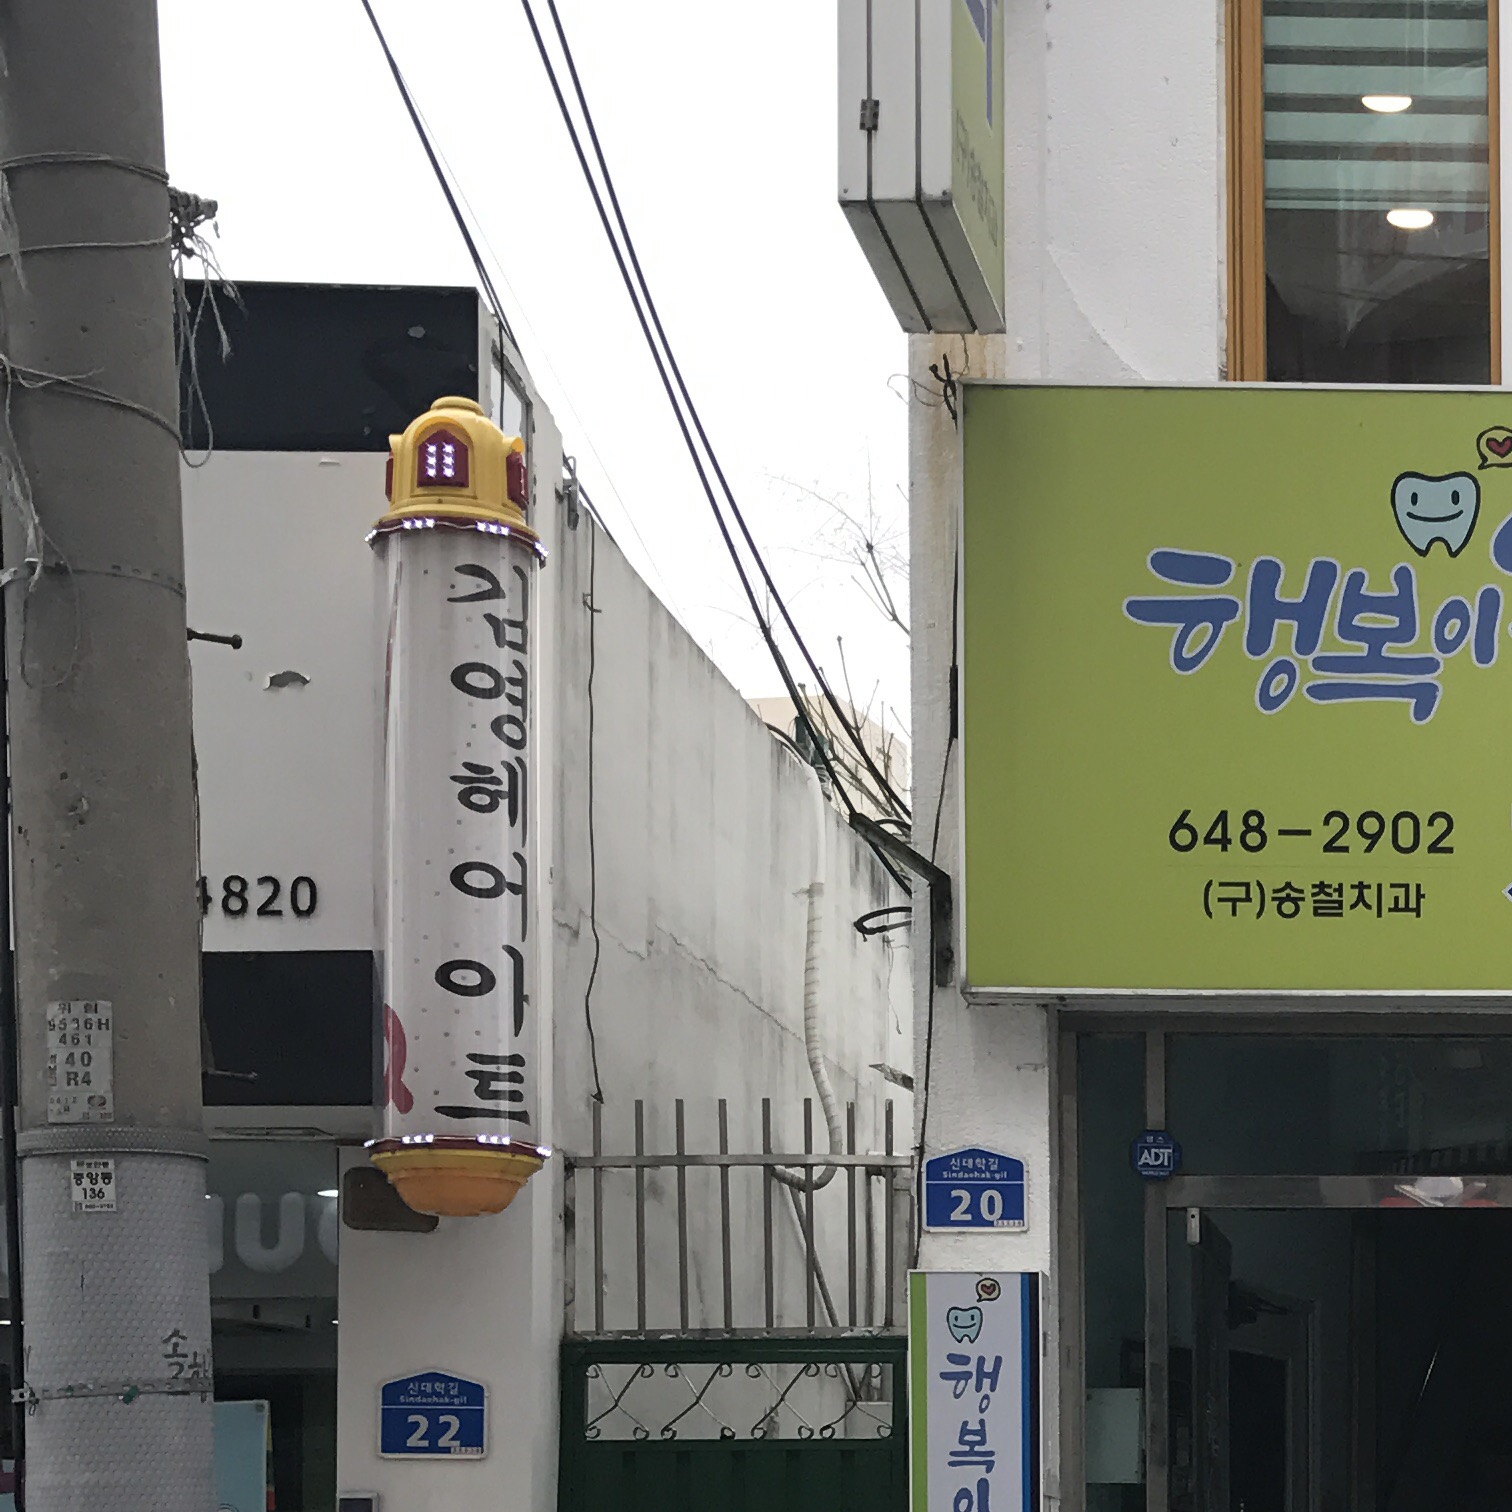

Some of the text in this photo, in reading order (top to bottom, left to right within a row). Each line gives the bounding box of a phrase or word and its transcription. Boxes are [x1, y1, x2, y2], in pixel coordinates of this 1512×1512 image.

[1168, 808, 1456, 855] 648-2902
[1200, 879, 1426, 922] (구)송철치과
[950, 1157, 998, 1171] 신대학길
[1138, 1148, 1172, 1165] ADT
[82, 1188, 105, 1200] 136
[950, 1189, 1003, 1222] 20
[408, 1381, 459, 1395] 신대학길
[407, 1415, 460, 1447] 22
